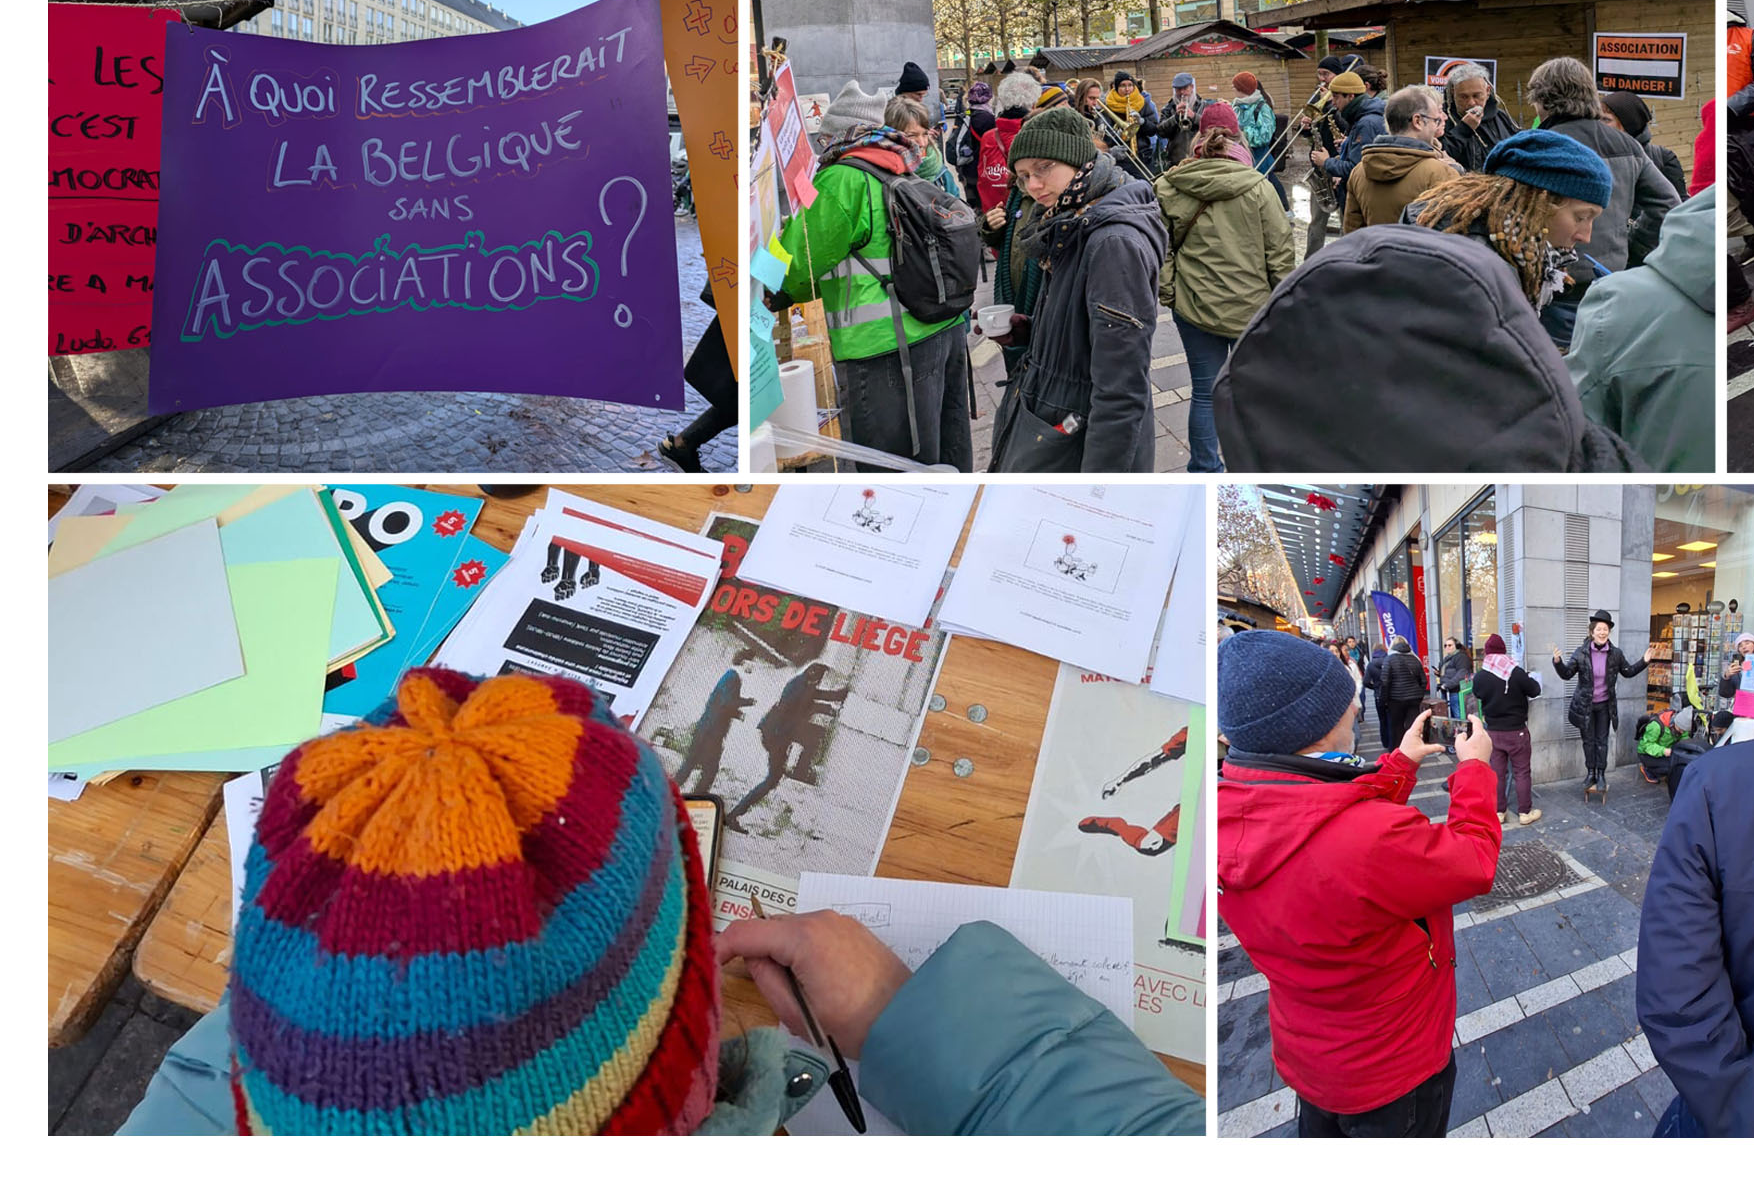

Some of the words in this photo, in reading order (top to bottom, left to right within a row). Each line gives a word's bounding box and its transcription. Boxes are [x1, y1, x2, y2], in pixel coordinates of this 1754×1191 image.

[1600, 40, 1679, 57] ASSOCIATION
[93, 46, 165, 95] LES
[195, 48, 239, 122] À
[249, 73, 336, 120] QUOI
[358, 26, 635, 112] RESSEMBLERAIT
[1602, 76, 1616, 89] EN
[1618, 77, 1665, 92] DANGER
[1667, 79, 1673, 92] !
[51, 112, 139, 140] C'EST
[272, 139, 339, 190] LA
[360, 109, 584, 188] BELGIQUE
[388, 193, 474, 223] SANS
[59, 221, 157, 247] D'ARCH
[190, 237, 592, 336] ASSOCIATIONS
[596, 174, 651, 329] ?
[710, 584, 776, 622] ORS
[781, 597, 824, 637] DE
[718, 875, 759, 898] PALAIS
[761, 884, 785, 905] DES
[1133, 973, 1188, 1003] AVEC
